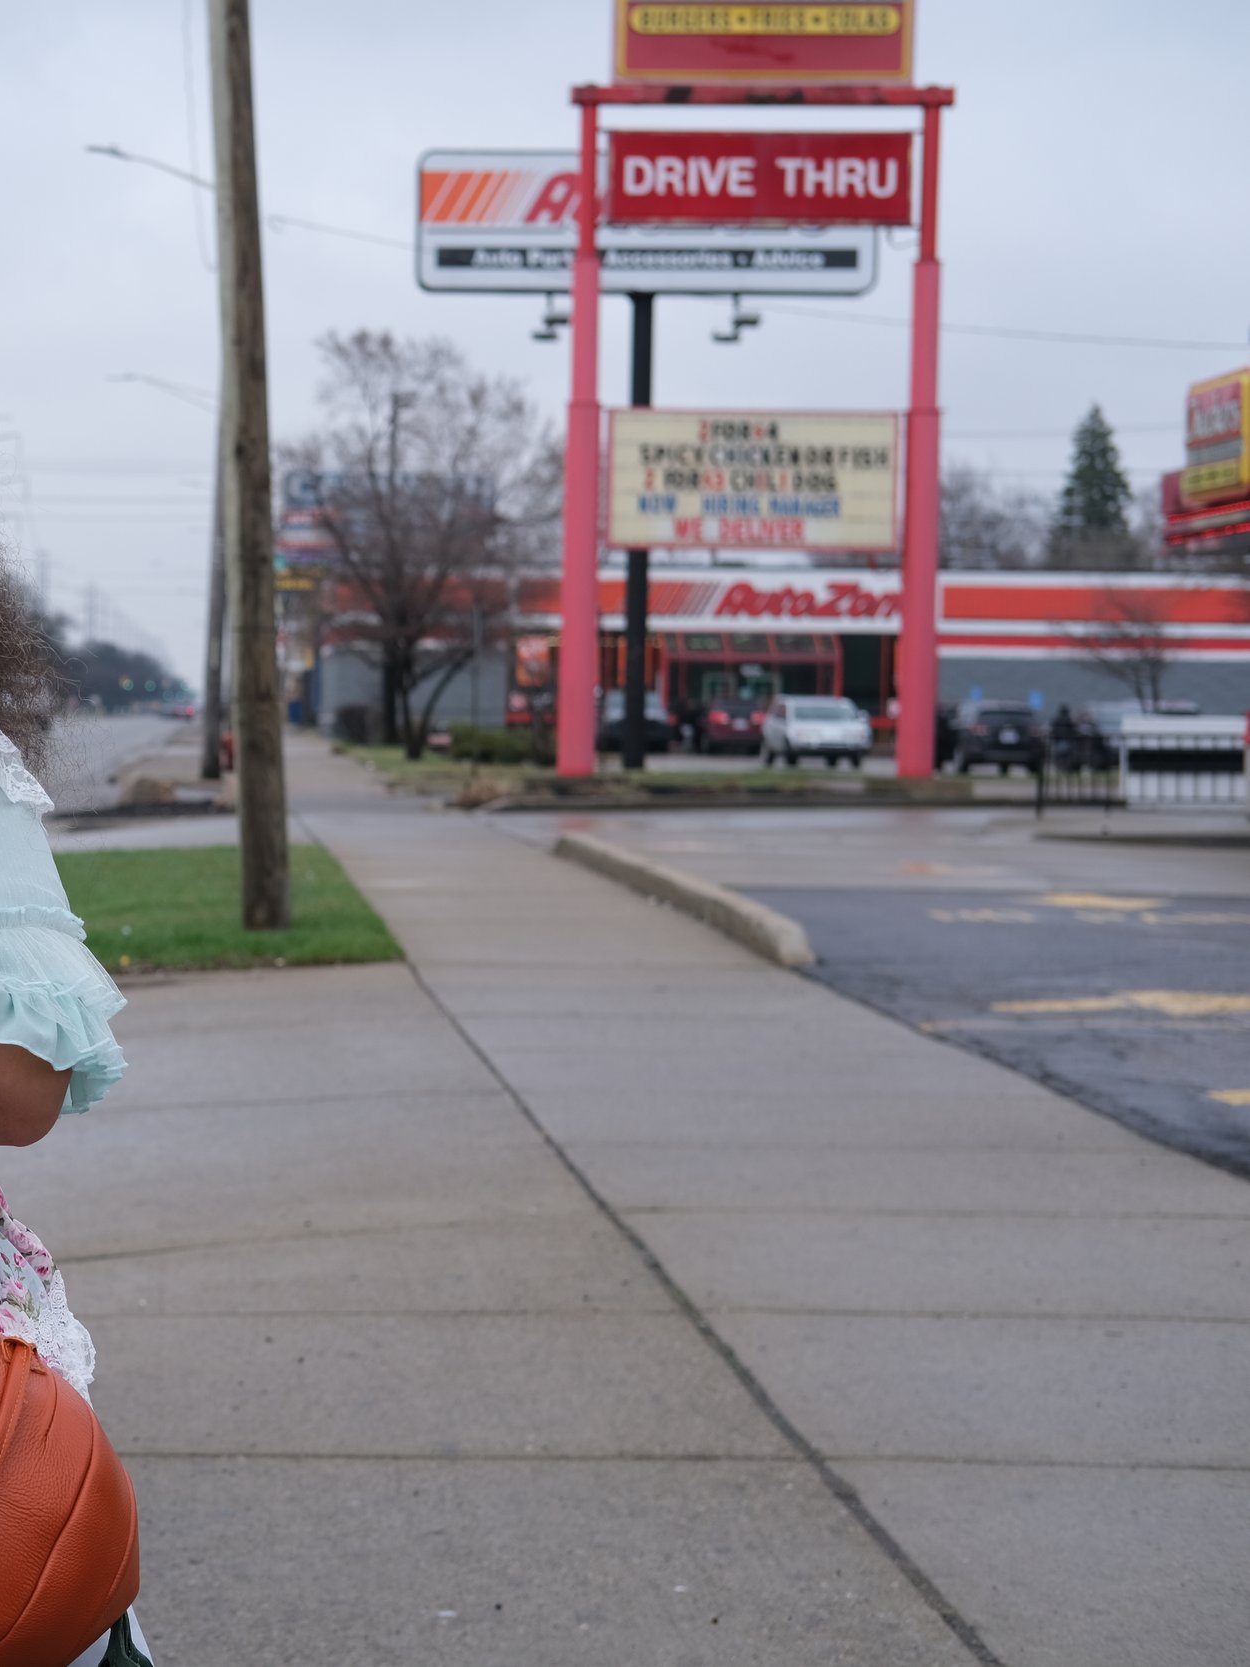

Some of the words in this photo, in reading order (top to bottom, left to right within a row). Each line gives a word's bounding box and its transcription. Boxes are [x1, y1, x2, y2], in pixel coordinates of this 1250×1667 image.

[623, 157, 755, 196] DRIVE
[777, 158, 898, 197] THRU
[471, 249, 524, 268] Auto
[526, 249, 575, 268] Part
[604, 249, 733, 269] Accessories
[752, 249, 824, 269] Advice
